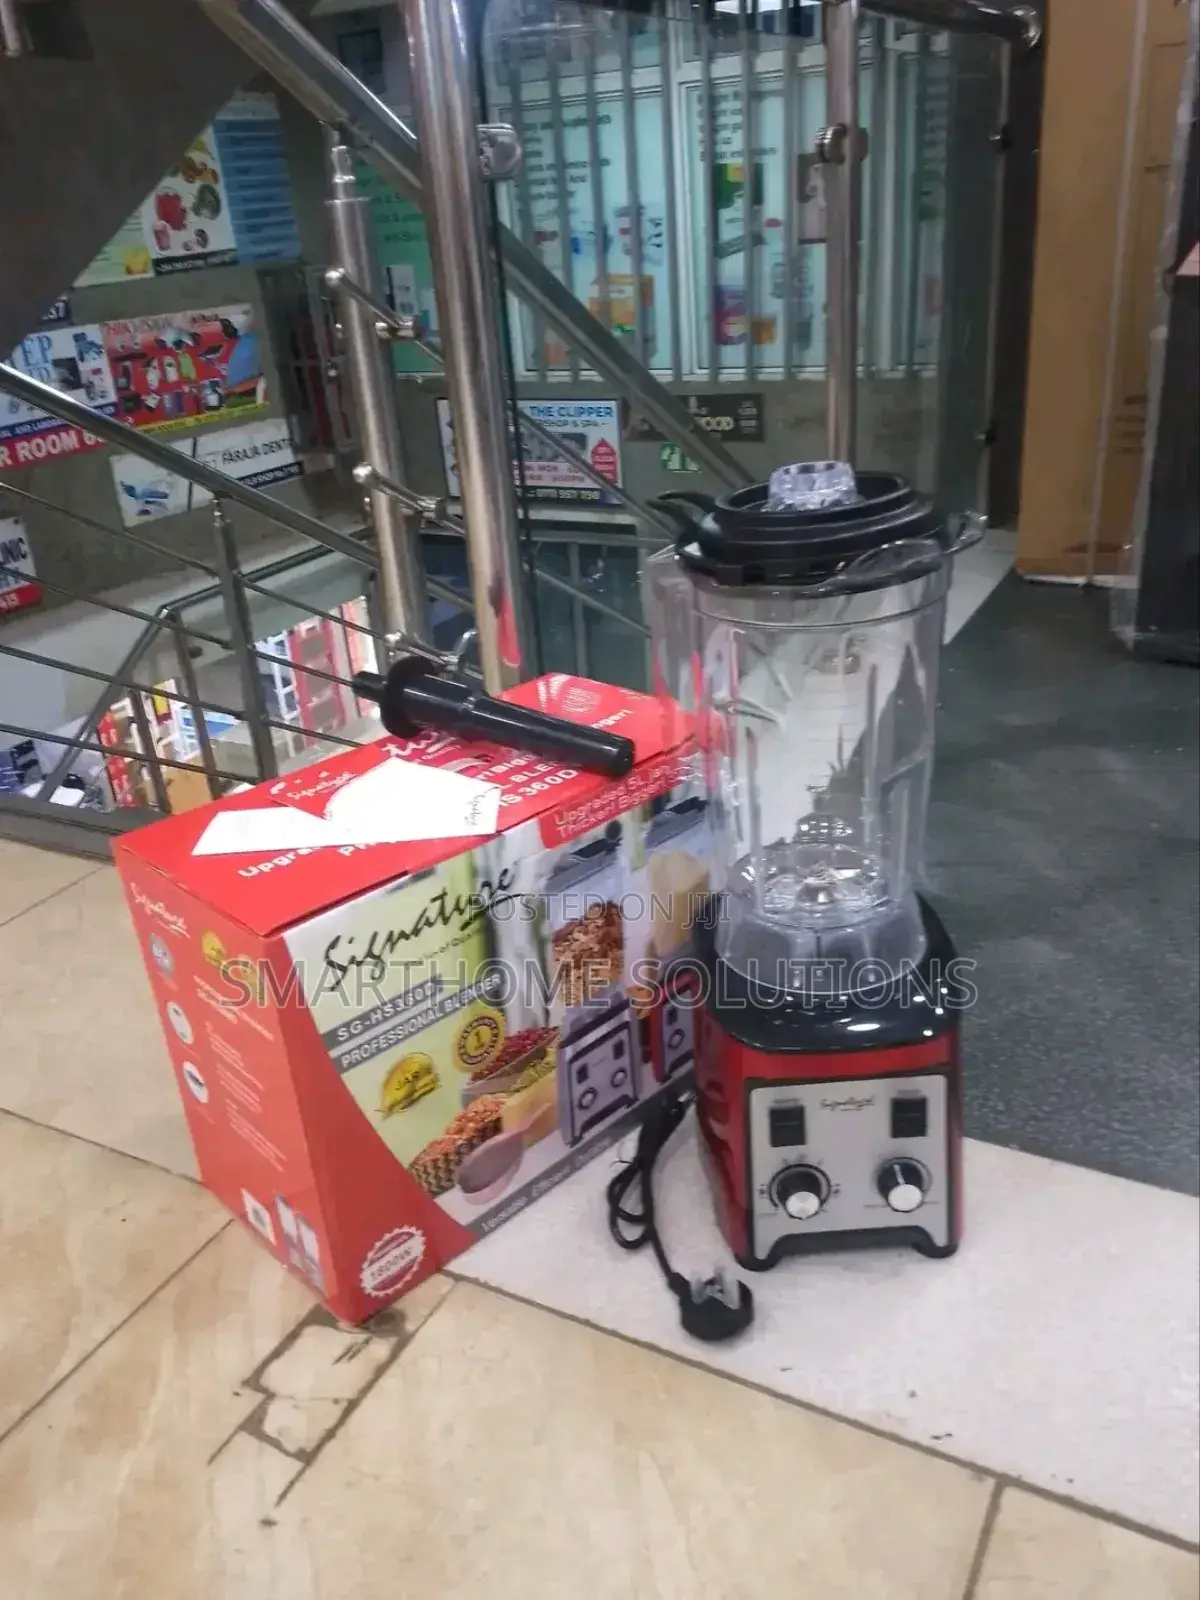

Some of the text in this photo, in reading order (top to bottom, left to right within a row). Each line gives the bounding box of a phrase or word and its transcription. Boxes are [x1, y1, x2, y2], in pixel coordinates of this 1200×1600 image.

[529, 405, 614, 418] THE CLIPPER
[15, 429, 81, 462] ROOM
[517, 769, 579, 796] 360D
[340, 1003, 446, 1068] PROFESSIONAL
[444, 973, 502, 1013] BLENDER
